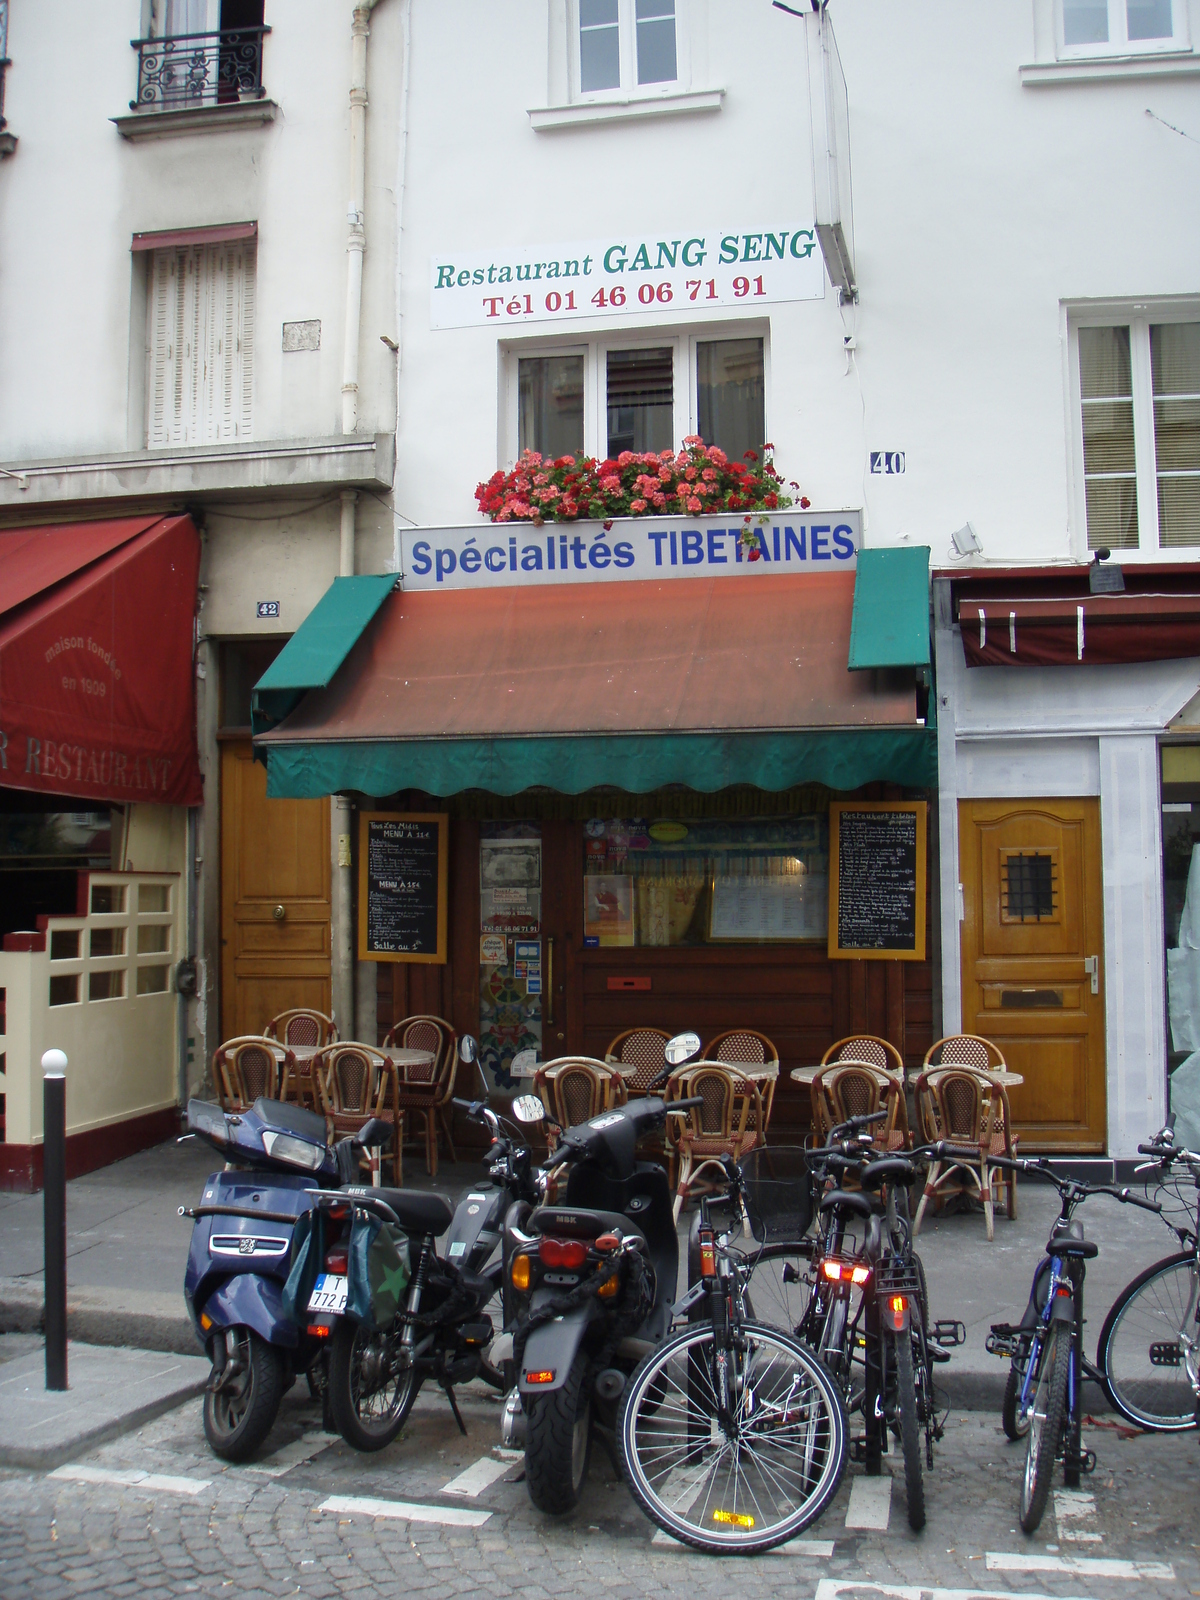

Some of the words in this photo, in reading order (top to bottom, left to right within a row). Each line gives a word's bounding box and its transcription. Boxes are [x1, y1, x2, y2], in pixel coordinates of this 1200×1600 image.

[434, 255, 593, 289] Restaurant
[603, 238, 707, 274] GANG
[718, 229, 816, 265] SENG
[483, 294, 534, 317] Tél
[545, 290, 577, 311] 01
[591, 286, 626, 308] 46
[638, 282, 673, 304] 06
[686, 278, 719, 300] 71
[732, 275, 766, 297] 91
[872, 452, 906, 474] 40
[412, 532, 635, 582] Spécialités
[648, 524, 855, 567] TIBETAINES
[259, 603, 277, 615] 42
[45, 637, 83, 663] maison
[88, 637, 122, 680] fondée
[62, 676, 76, 690] en
[81, 677, 106, 697] 1909
[25, 735, 172, 791] RESTAURANT
[384, 830, 404, 838] MENU
[379, 880, 398, 888] MENU
[374, 941, 396, 950] Salle
[556, 1215, 577, 1224] MBK
[335, 1277, 343, 1291] T
[314, 1292, 337, 1308] 772
